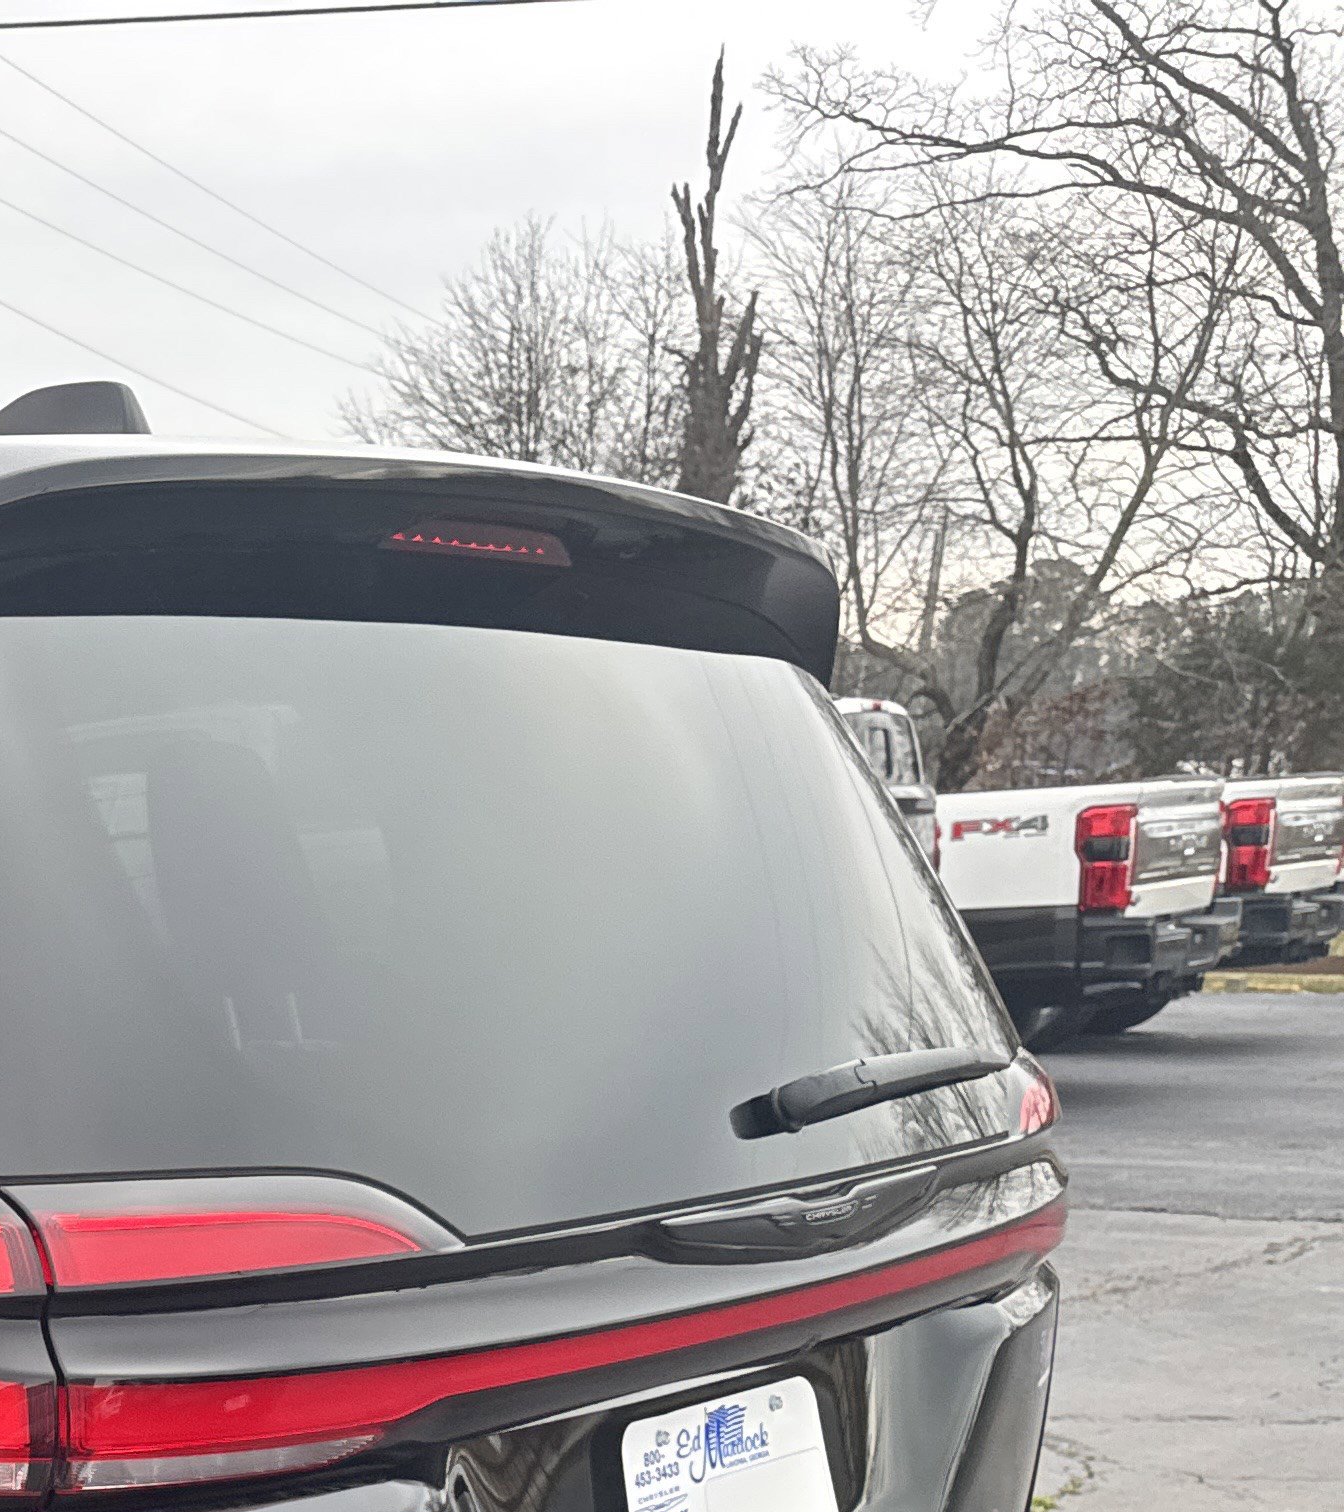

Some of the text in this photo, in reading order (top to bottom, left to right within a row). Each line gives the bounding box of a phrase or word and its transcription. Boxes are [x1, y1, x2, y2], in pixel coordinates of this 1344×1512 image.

[951, 815, 1049, 842] FX4
[677, 1425, 702, 1458] Ed
[635, 1461, 680, 1488] 453-3433
